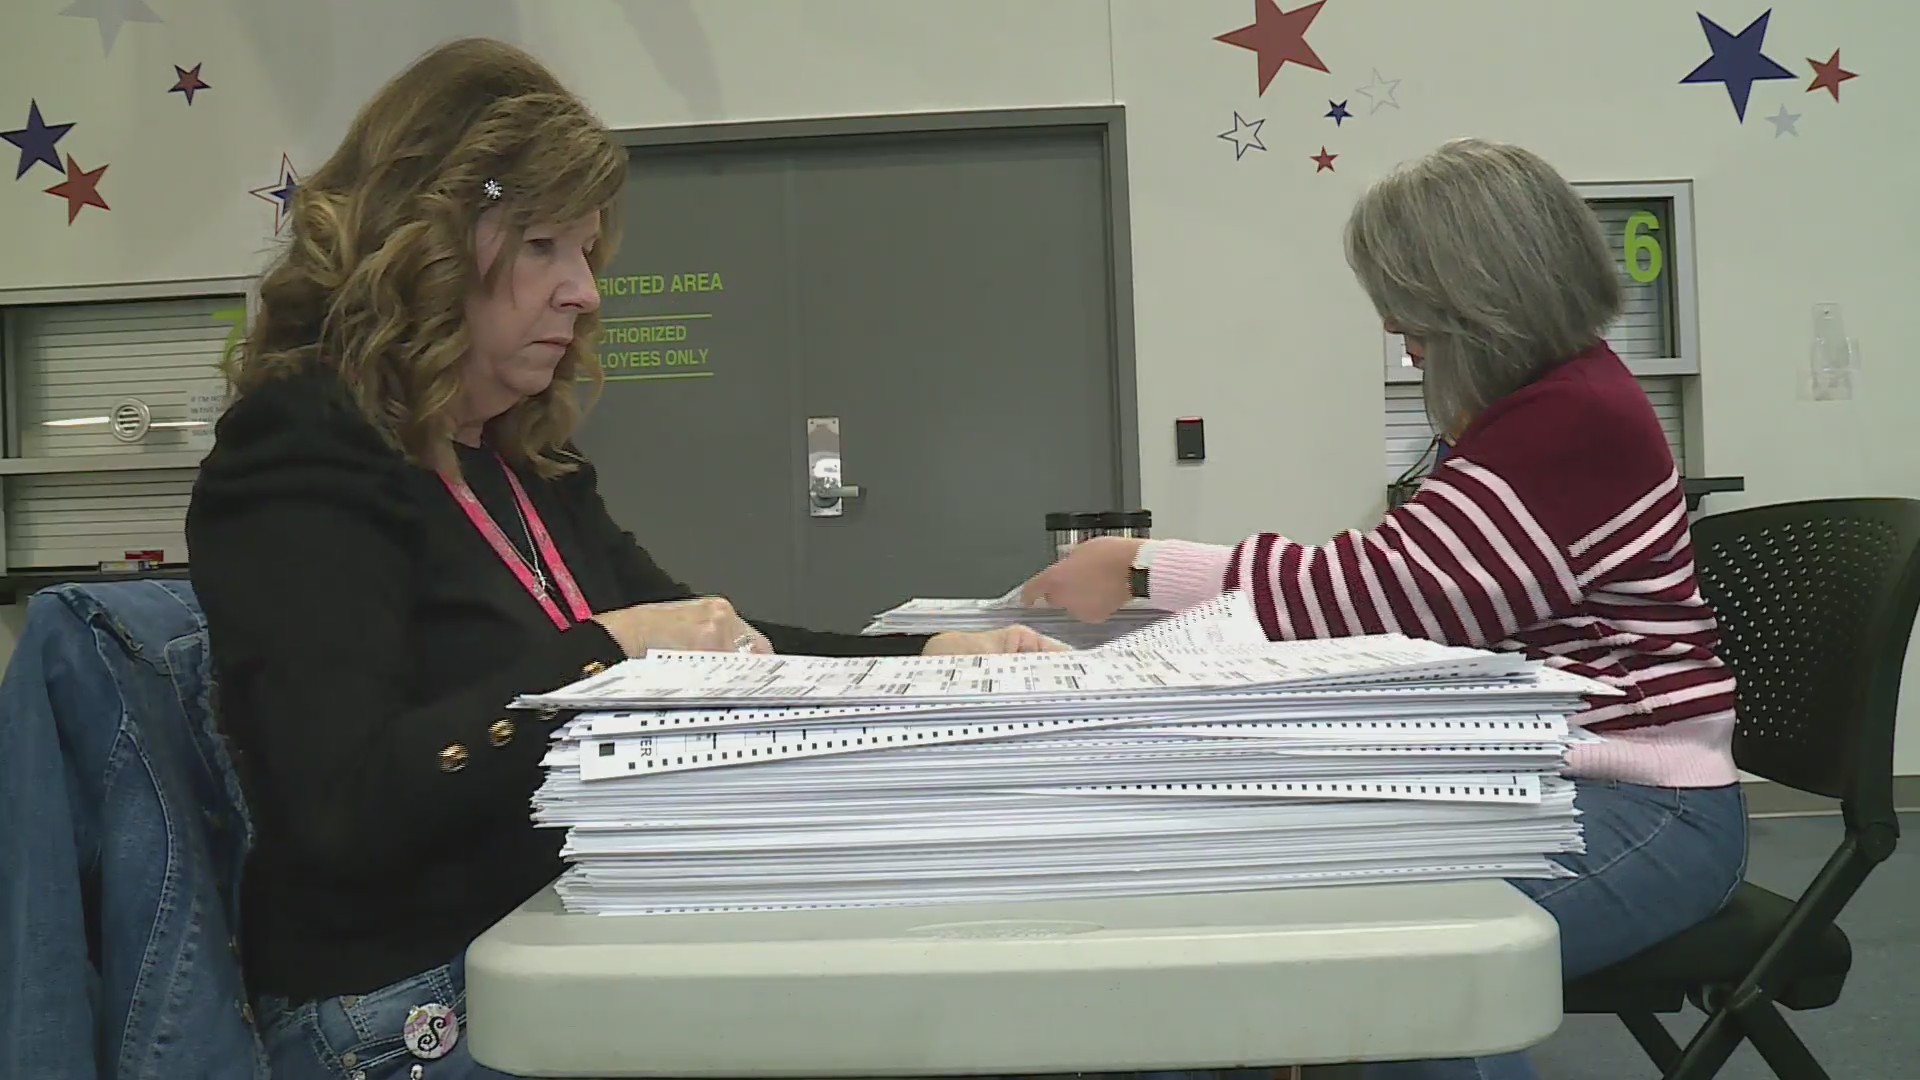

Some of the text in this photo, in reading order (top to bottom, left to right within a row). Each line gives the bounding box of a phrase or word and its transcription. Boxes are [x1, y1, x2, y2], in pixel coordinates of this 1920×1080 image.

[1624, 211, 1662, 284] 6
[598, 272, 724, 296] RICTED AREA
[598, 349, 709, 368] LOYEES ONLY
